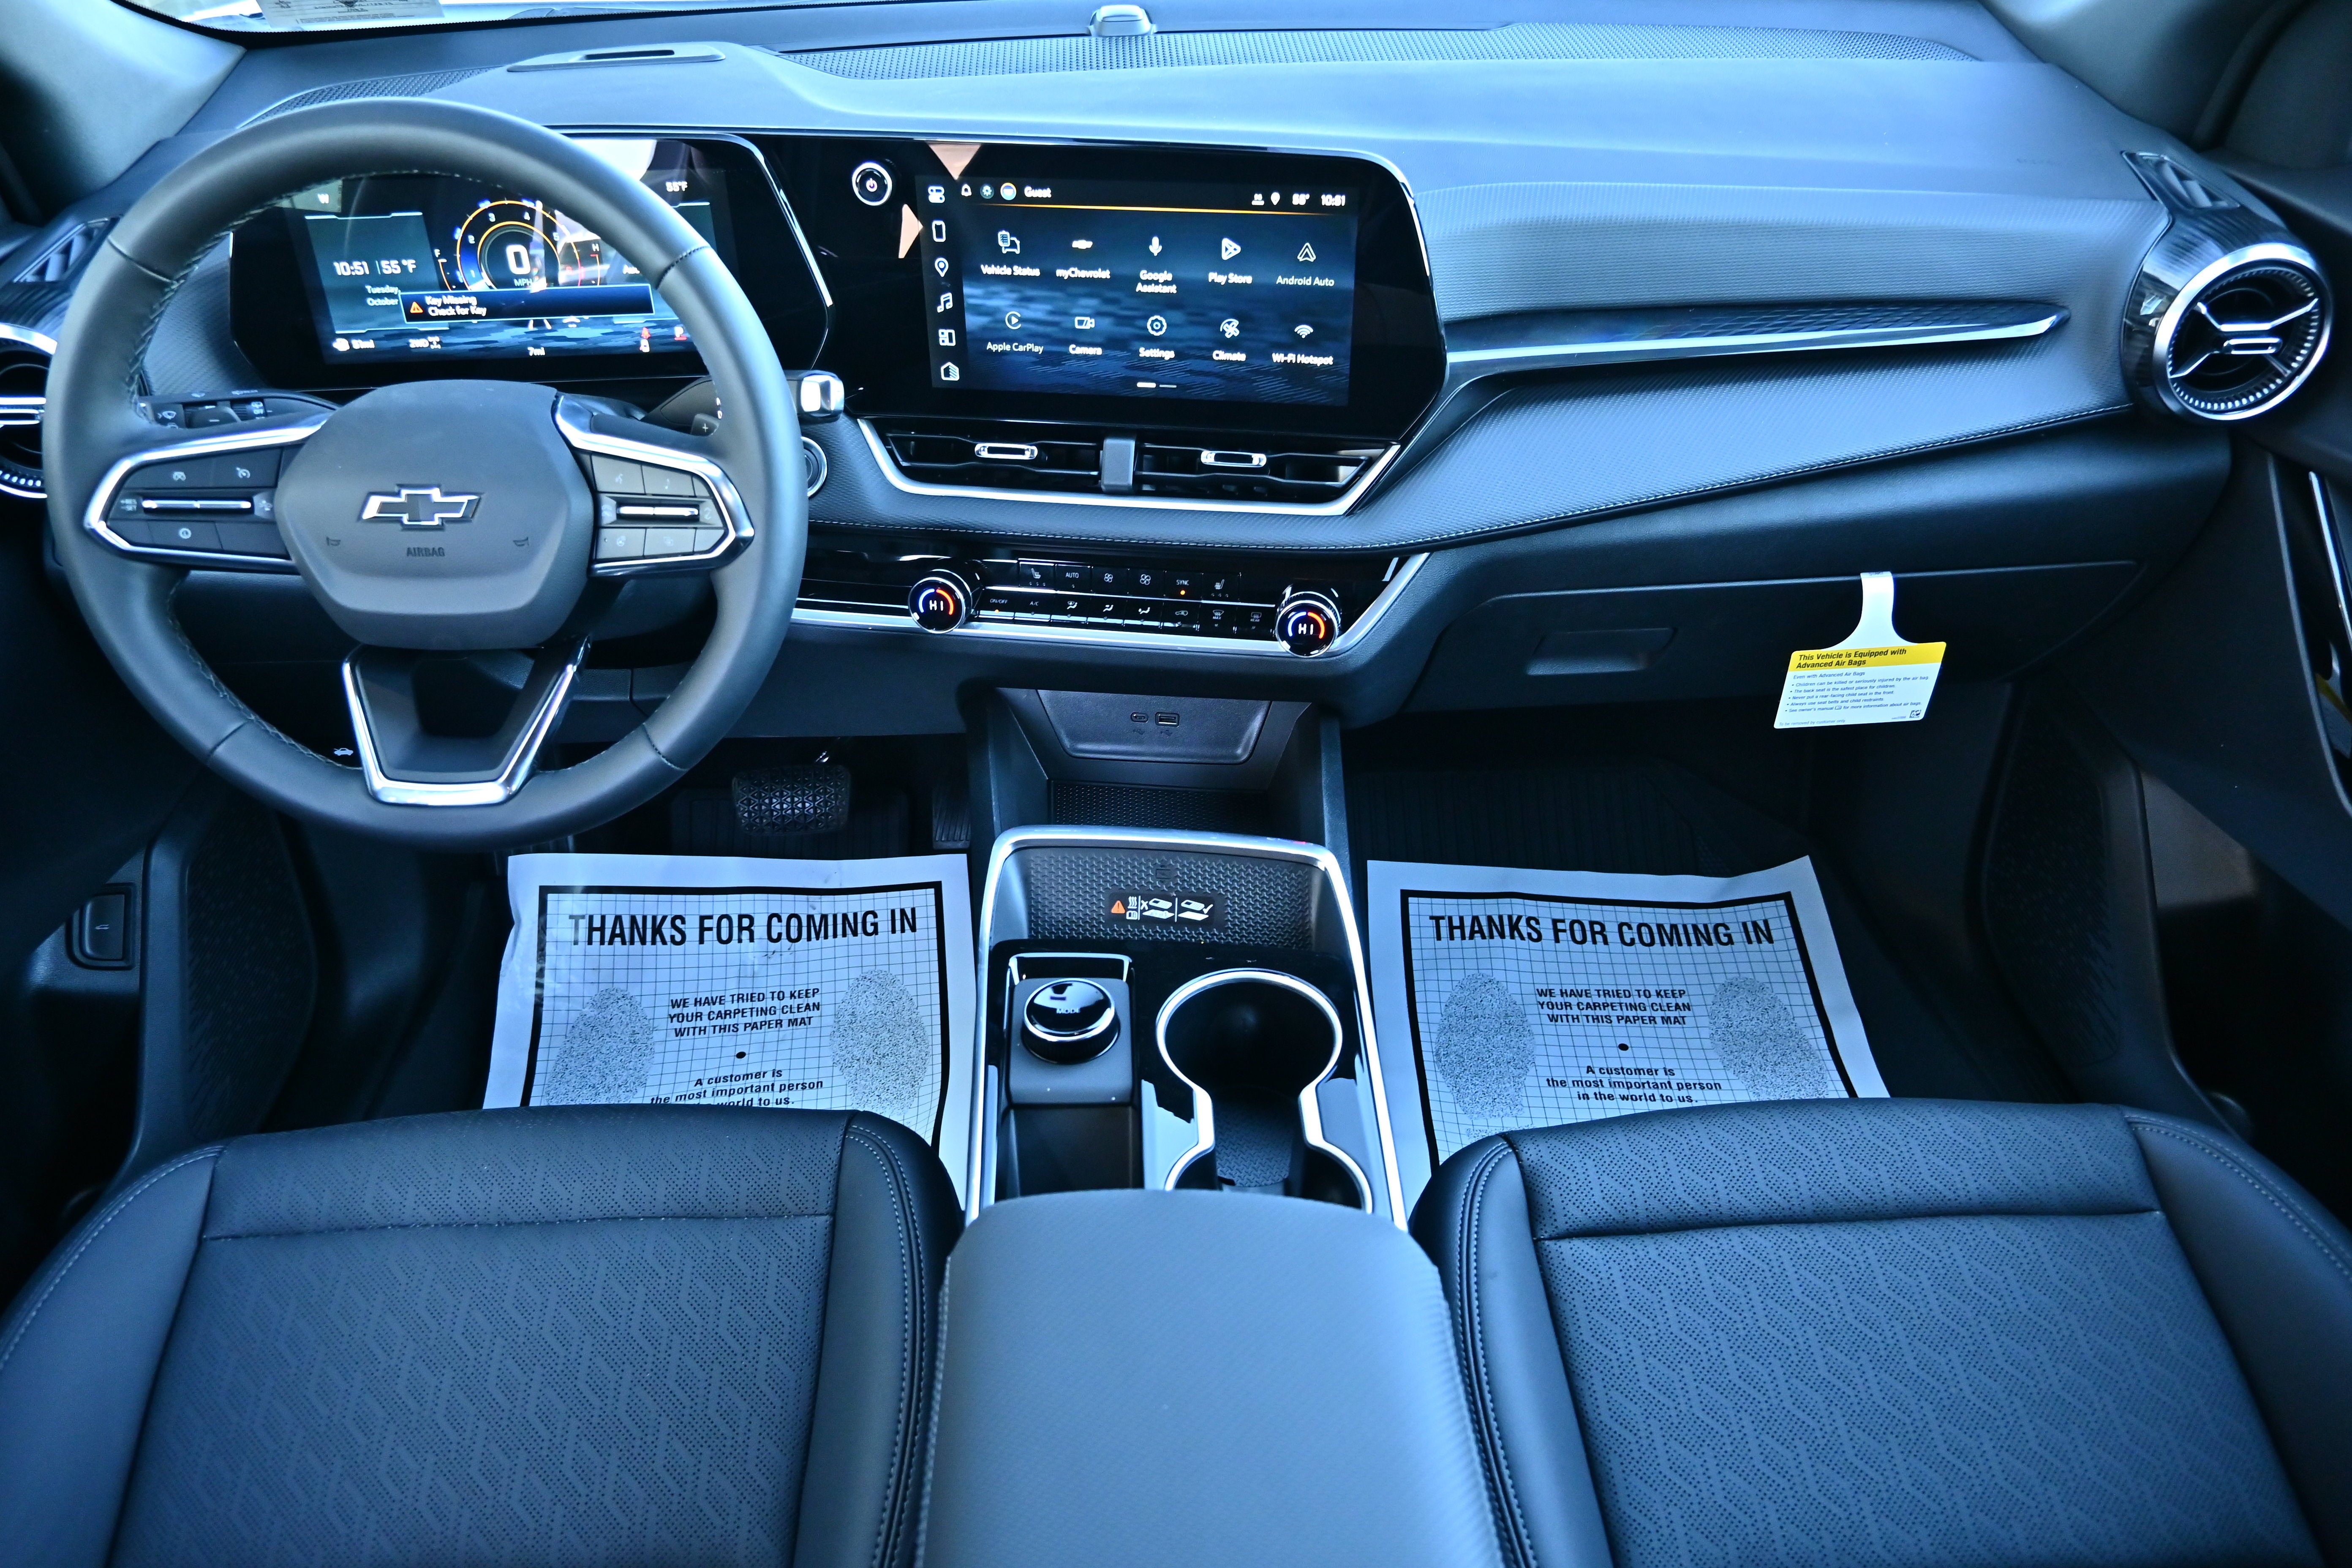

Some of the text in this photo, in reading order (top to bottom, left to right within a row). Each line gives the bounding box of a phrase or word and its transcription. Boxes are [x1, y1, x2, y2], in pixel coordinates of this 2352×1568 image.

[1024, 186, 1051, 198] Guest
[317, 193, 329, 204] W
[1321, 194, 1346, 207] 10:51
[488, 213, 495, 222] 3
[524, 212, 530, 220] 4
[468, 235, 475, 244] 2
[553, 232, 559, 241] 5
[434, 249, 440, 257] F
[507, 245, 531, 275] 0
[333, 261, 369, 275] 10:51
[381, 260, 401, 274] 55
[981, 265, 1040, 277] Vehicle Status
[1056, 267, 1111, 279] myChevrolet
[1140, 270, 1173, 282] Google
[1209, 272, 1252, 285] Play Store
[1276, 276, 1334, 286] Android Auto
[1136, 283, 1177, 293] Assistant
[367, 297, 398, 306] October
[425, 295, 477, 306] Key Missing
[428, 306, 487, 317] Check for Key
[675, 326, 684, 337] P
[987, 342, 1044, 354] Apple CarPlay
[1069, 345, 1102, 355] Camera
[1139, 348, 1175, 360] Settings
[1212, 350, 1246, 362] Climate
[1272, 353, 1334, 367] Wi-Fi Hotspot
[406, 547, 445, 557] AIRBAG
[929, 600, 944, 611] HI
[1298, 623, 1314, 635] HI
[1854, 649, 1888, 659] Equipped
[1796, 660, 1832, 669] Advanced
[1848, 659, 1866, 667] Bags
[569, 907, 917, 946] THANKS FOR COMING IN
[1429, 915, 1774, 947] THANKS FOR COMING IN
[670, 988, 820, 1009] WE HAVE TRIED TO KEEP
[1536, 988, 1686, 998] WE HAVE TRIED TO KEEP
[1537, 1001, 1692, 1012] YOUR CARPETING CLEAN
[668, 1002, 820, 1024] YOUR CARPETING CLEAN
[1547, 1014, 1687, 1025] WITH THIS PAPER MAT
[674, 1016, 813, 1037] WITH THIS PAPER MAT
[1586, 1065, 1675, 1076] A customer is
[694, 1069, 782, 1087] A customer is
[1546, 1077, 1722, 1092] the most important person
[651, 1079, 824, 1104] the most important person
[1577, 1091, 1699, 1103] in the world to us.
[759, 1097, 770, 1106] to
[775, 1097, 795, 1105] us.
